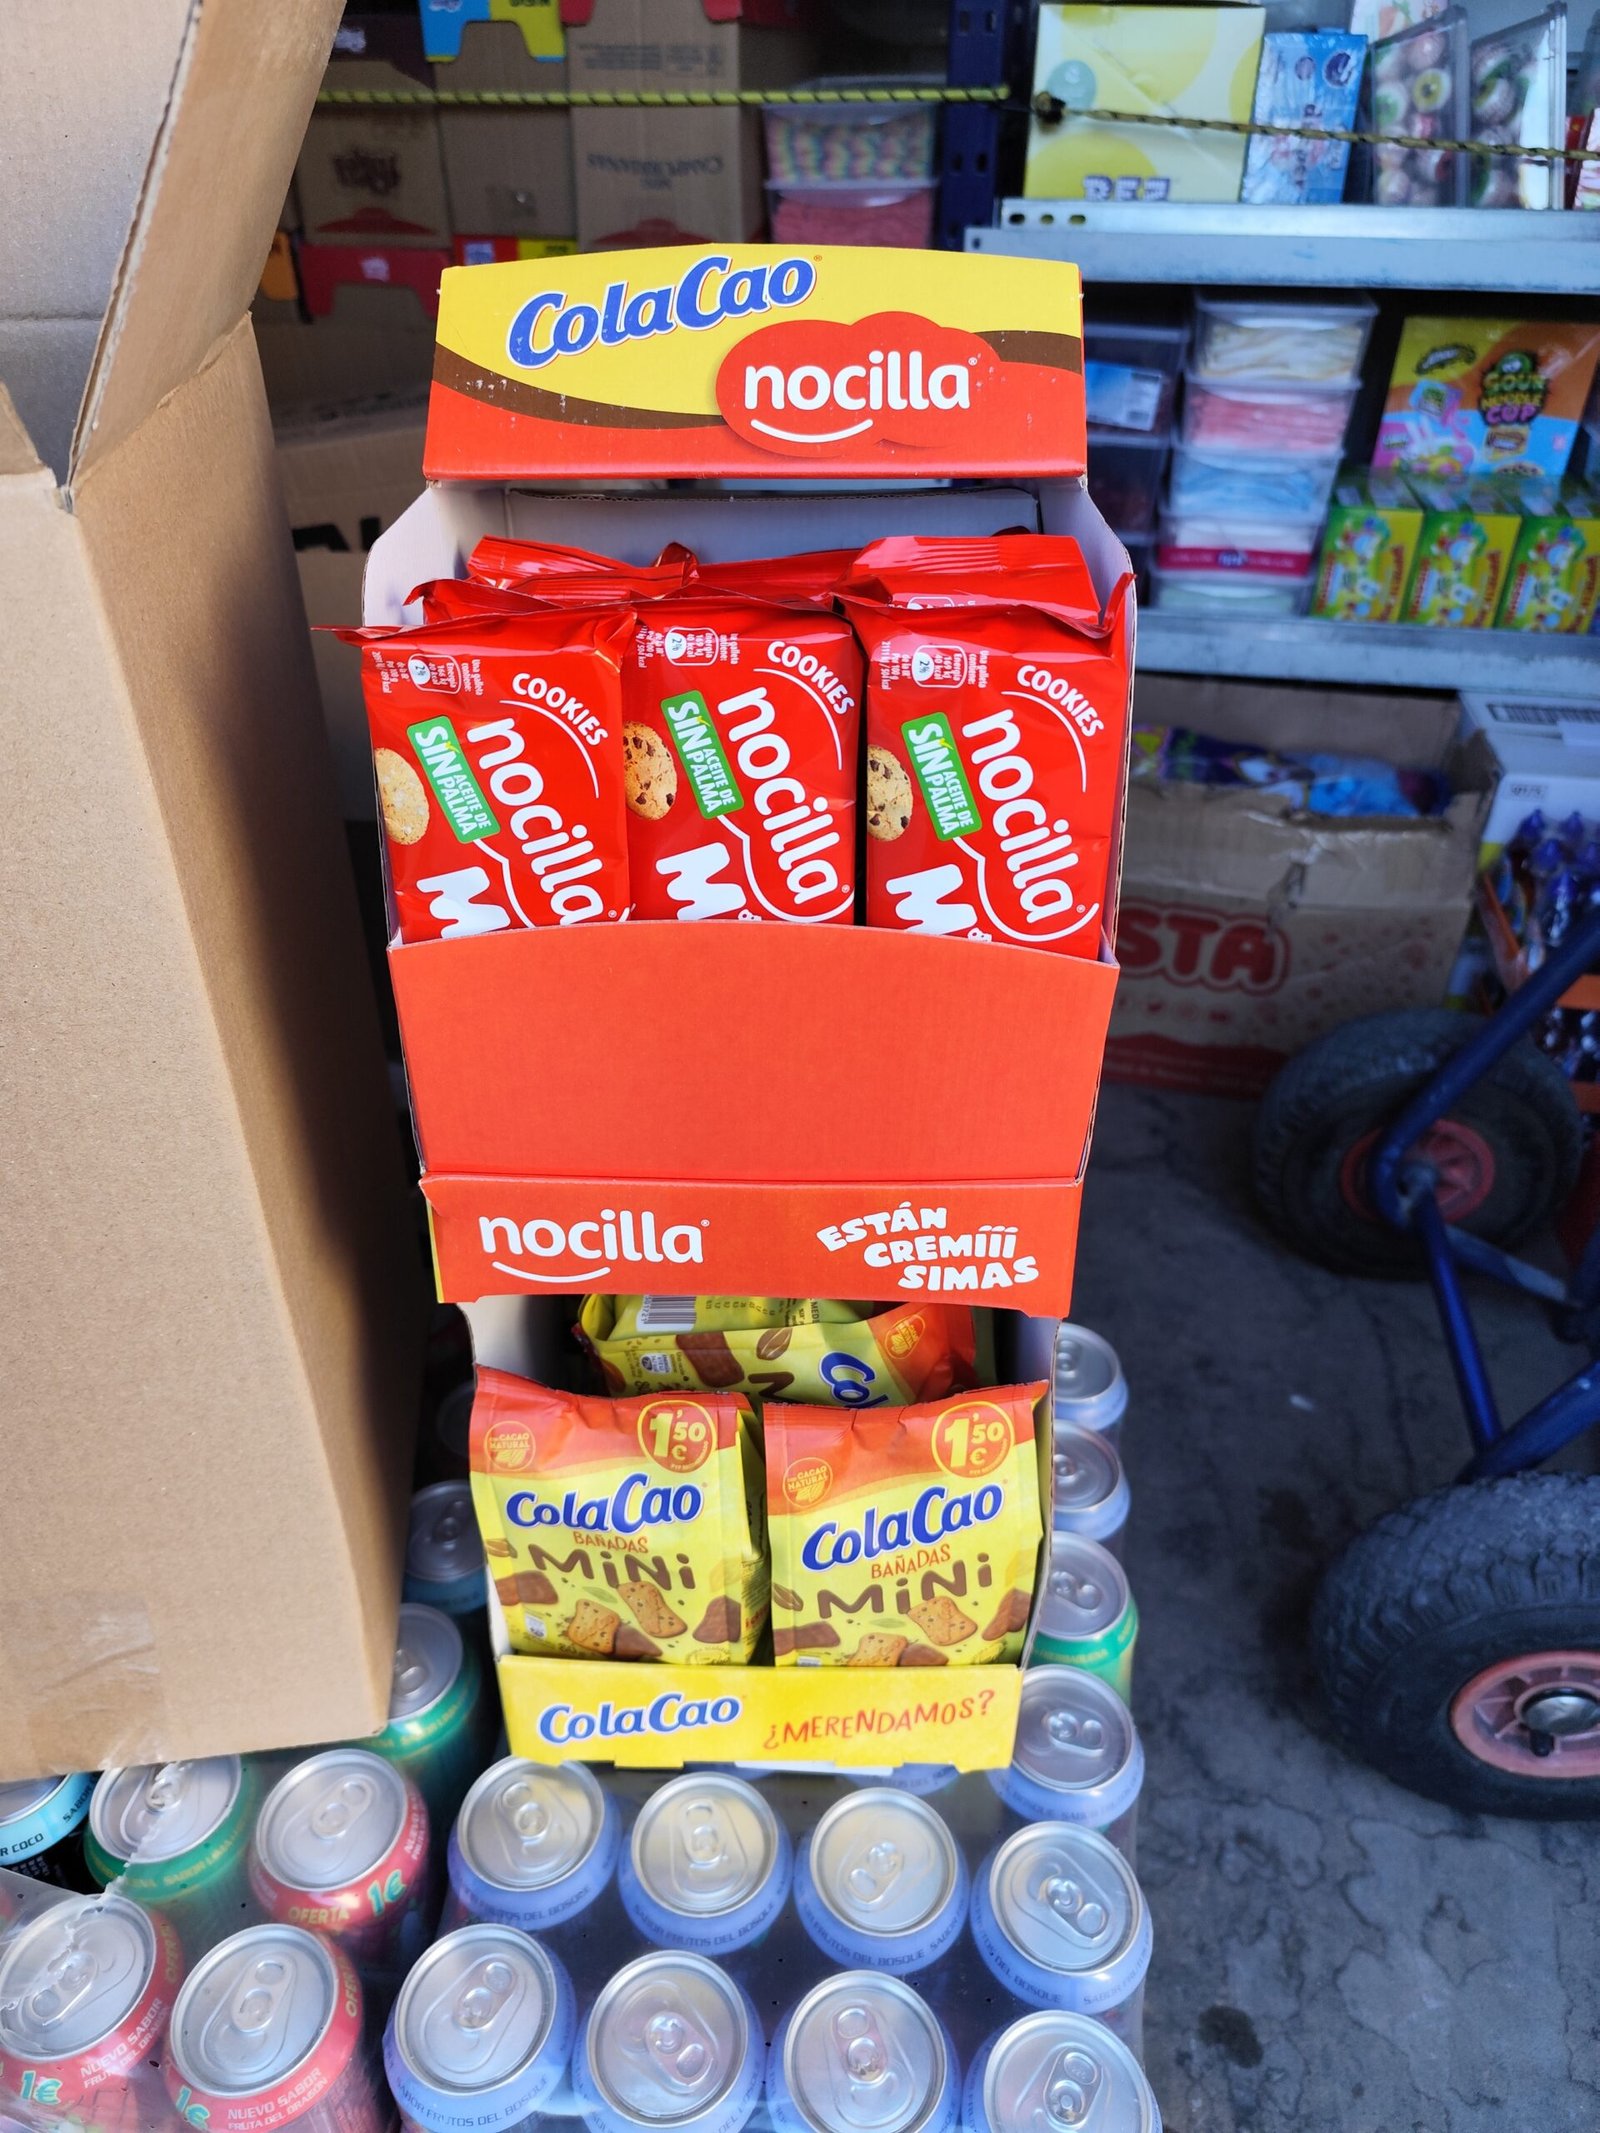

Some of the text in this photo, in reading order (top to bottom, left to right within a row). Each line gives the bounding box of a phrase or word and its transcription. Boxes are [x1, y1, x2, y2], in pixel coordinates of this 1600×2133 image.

[506, 256, 818, 369] ColaCao
[744, 350, 971, 410] nocilla
[1486, 403, 1537, 423] CUP
[767, 641, 855, 715] COOKIES
[1016, 665, 1104, 737] COOKIES
[512, 672, 609, 746] COOKIES
[667, 700, 713, 753] SIN
[415, 725, 464, 778] SIN
[908, 723, 955, 776] SIN
[452, 774, 492, 829] ACEITE DE
[685, 751, 721, 813] PALMA
[702, 748, 736, 806] ACEITE DE
[717, 686, 840, 905] nocilla
[942, 771, 974, 828] ACEITE DE
[436, 777, 478, 836] PALMA
[466, 718, 604, 925] nocilla
[924, 774, 957, 835] PALMA
[962, 709, 1079, 923] nocilla
[479, 1209, 703, 1263] nocilla
[816, 1201, 947, 1252] ESTÁN
[898, 1256, 1039, 1291] SIMAS
[788, 1471, 829, 1490] NATURAL
[797, 1465, 827, 1479] CACAO
[970, 1447, 987, 1465] €
[506, 1472, 703, 1533] ColaCao
[802, 1484, 1004, 1571] ColaCao
[574, 1531, 649, 1553] BAÑADAS
[871, 1543, 951, 1579] BAÑADAS
[538, 1693, 741, 1744] ColaCao
[764, 1689, 995, 1750] ¿MERENDAMOS?
[11, 1832, 44, 1853] COCO
[288, 1906, 350, 1925] OFERTA
[368, 1869, 406, 1917] 1€
[714, 1934, 735, 1946] DEL
[852, 1951, 876, 1966] DEL
[878, 1949, 925, 1966] BOSQUE
[1014, 1975, 1063, 2004] BOSQUE
[80, 1997, 163, 2079] NUEVO SABOR
[119, 2050, 140, 2066] DEL
[21, 2069, 63, 2105] 1€
[227, 2067, 323, 2120] NUEVO SABOR
[227, 2119, 264, 2132] FRUTA
[264, 2112, 286, 2124] DEL
[478, 2114, 502, 2127] DEL
